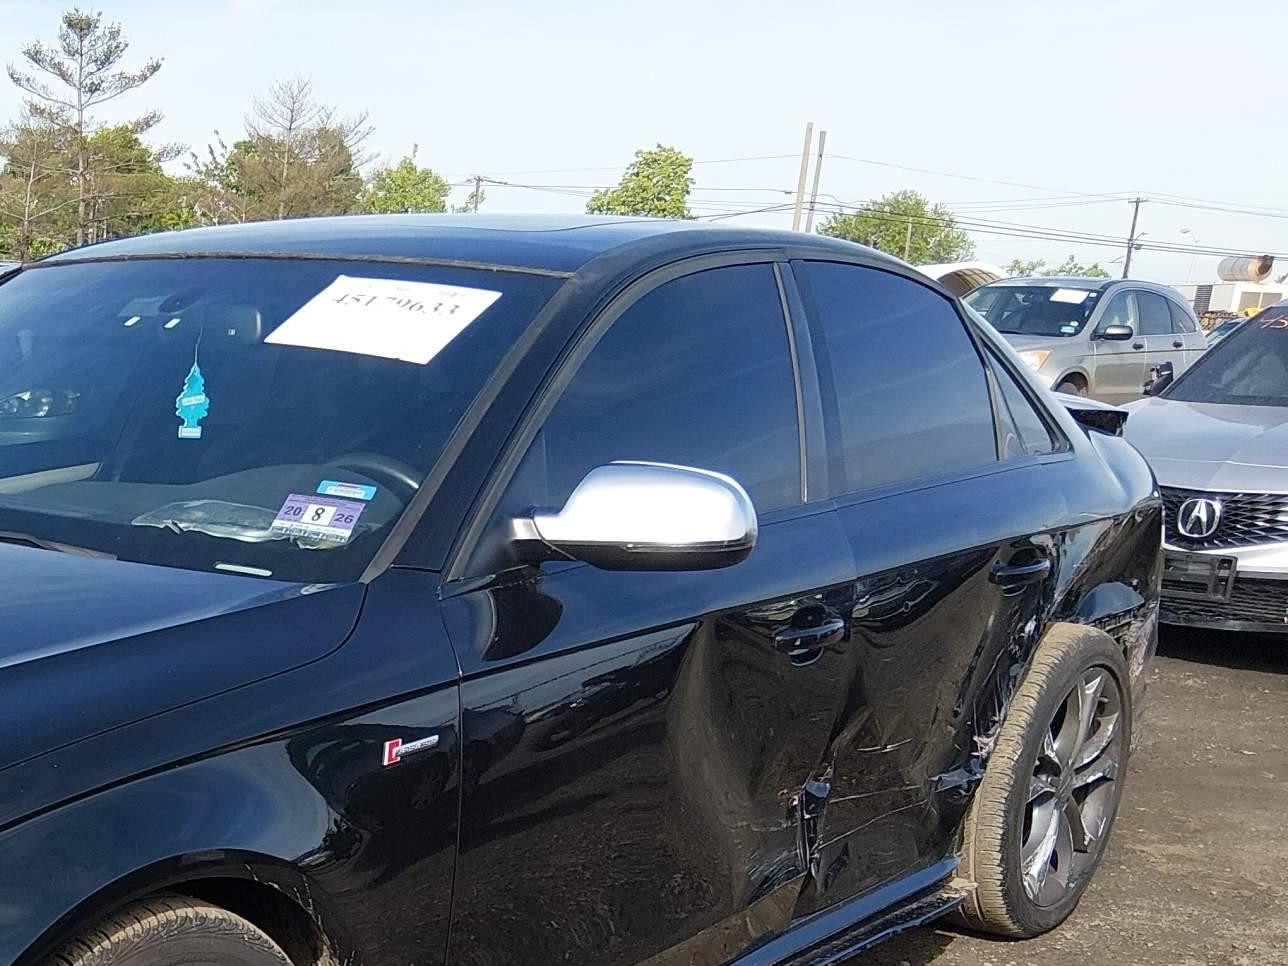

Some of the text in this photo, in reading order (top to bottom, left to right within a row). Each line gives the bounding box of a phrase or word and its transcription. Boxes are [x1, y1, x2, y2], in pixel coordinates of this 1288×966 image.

[331, 293, 460, 315] 4519633
[283, 505, 355, 524] 20 8 26
